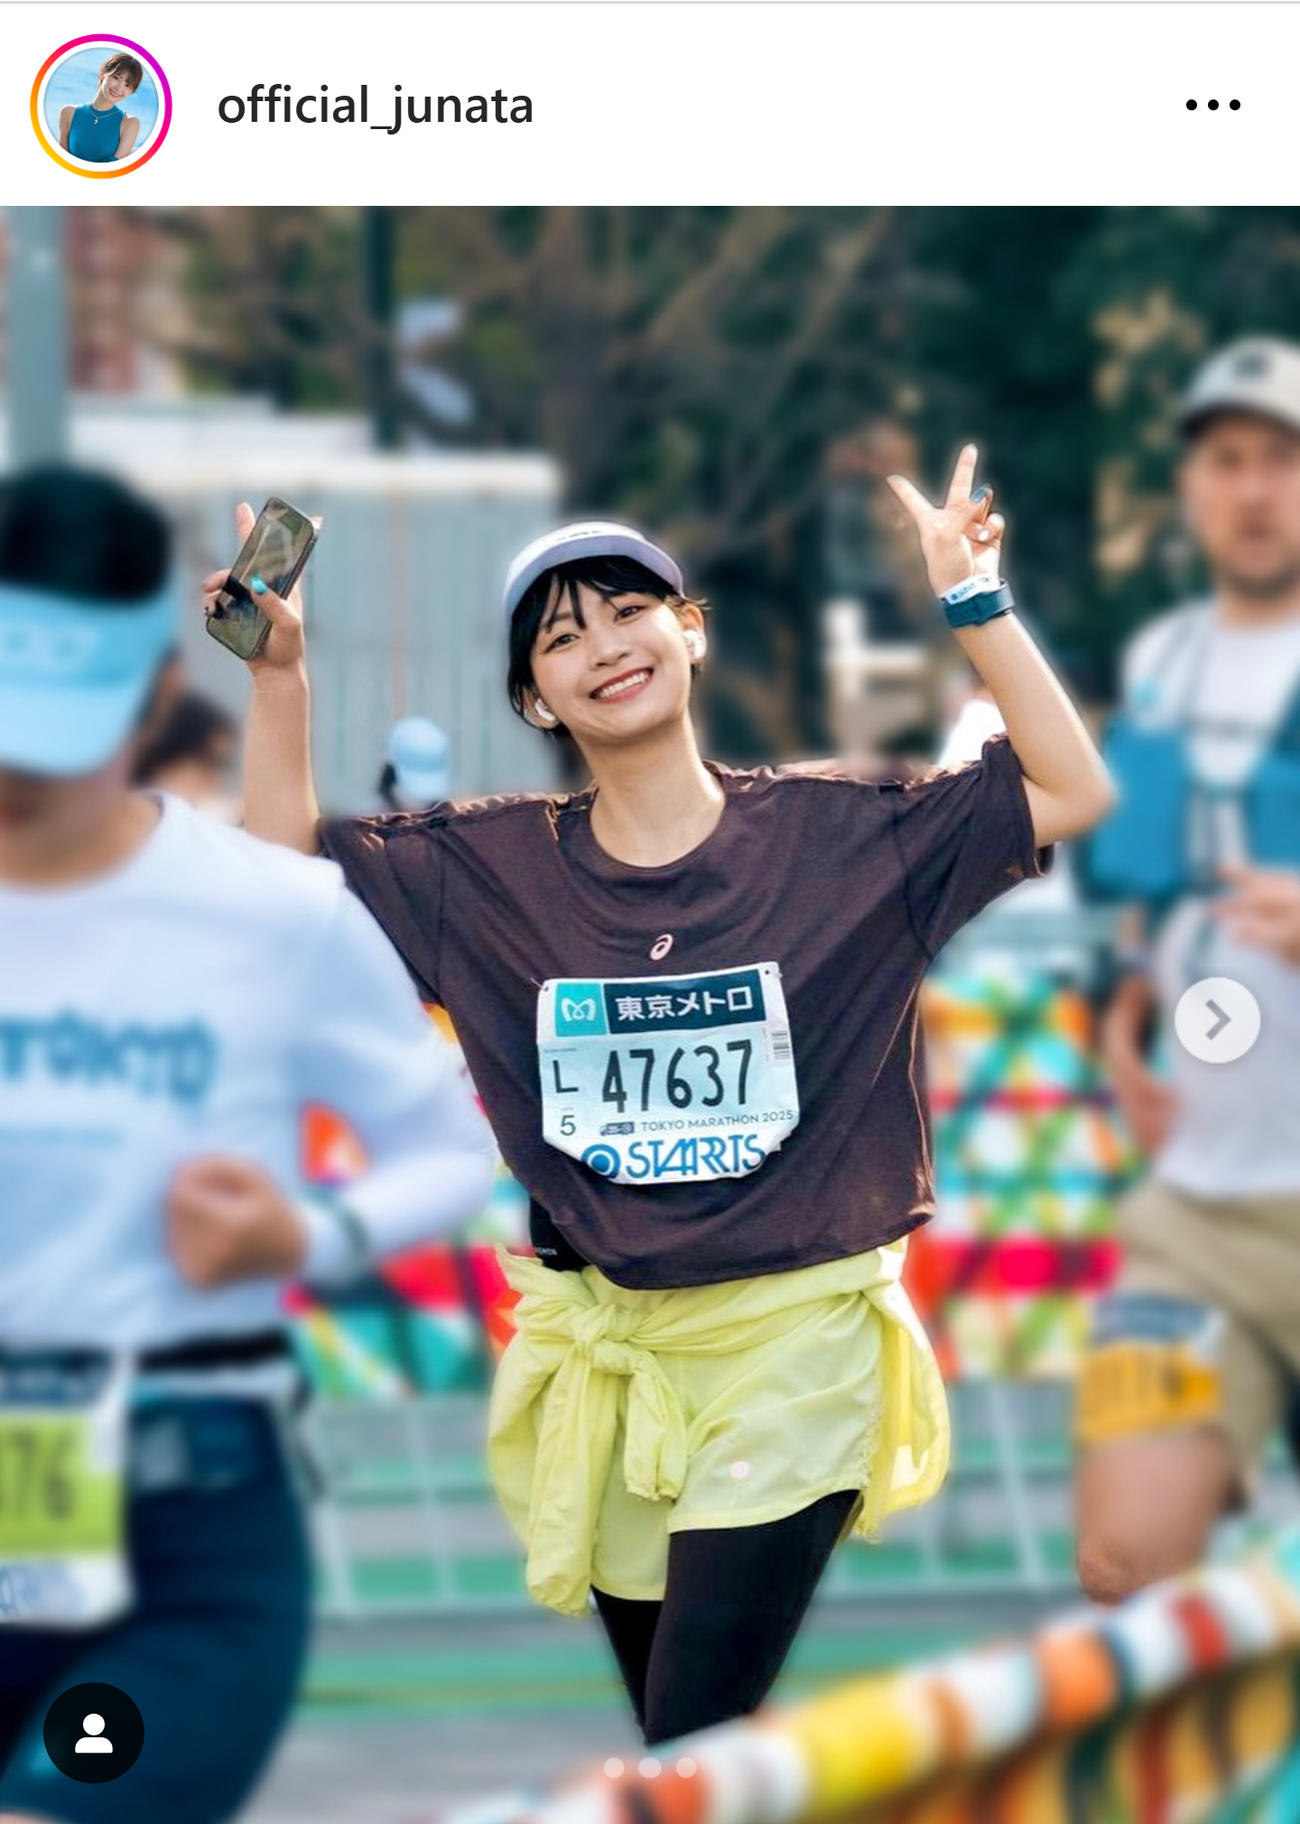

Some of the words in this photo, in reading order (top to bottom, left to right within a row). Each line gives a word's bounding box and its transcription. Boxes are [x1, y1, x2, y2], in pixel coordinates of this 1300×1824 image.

[615, 986, 753, 1022] 東京メトロ
[553, 1059, 579, 1094] L
[602, 1039, 753, 1113] 47637
[560, 1114, 577, 1136] 5
[641, 1119, 685, 1133] TOKYO
[687, 1112, 759, 1129] MARATHON
[762, 1109, 794, 1123] 2025
